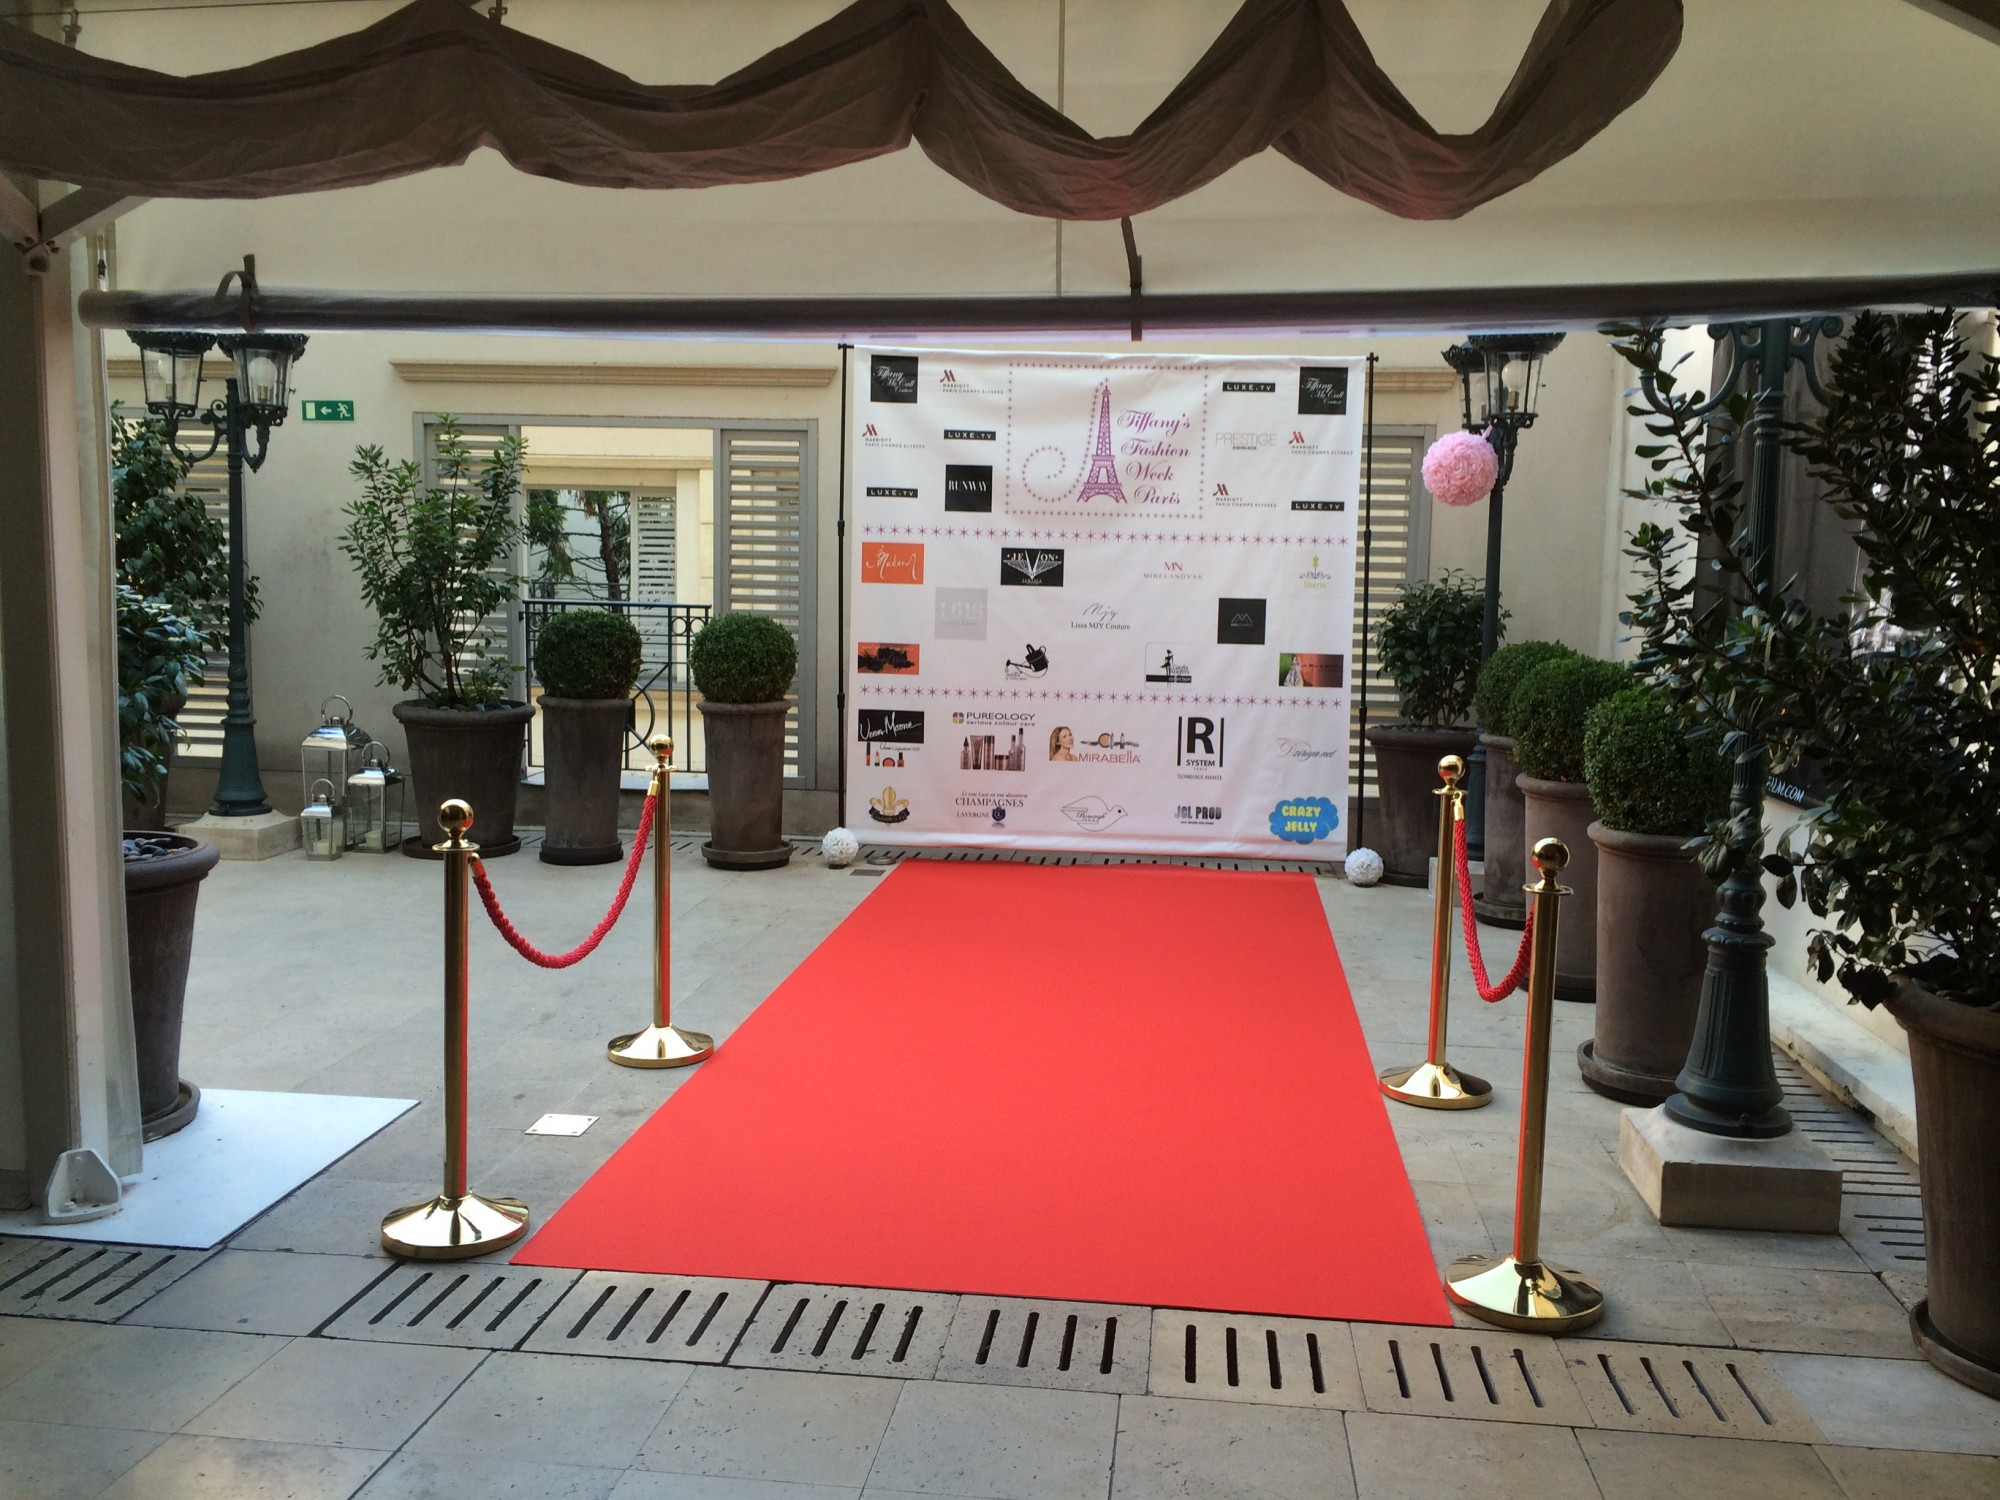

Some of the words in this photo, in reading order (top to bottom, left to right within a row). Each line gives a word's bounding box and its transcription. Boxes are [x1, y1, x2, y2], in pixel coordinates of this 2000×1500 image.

[1226, 383, 1271, 391] LUXE.TV
[1117, 410, 1190, 437] Tiffany's
[948, 431, 992, 439] LUXE.TV
[1215, 432, 1278, 447] PRESTIGE
[1120, 438, 1190, 457] Fashion
[1125, 460, 1174, 481] Week
[948, 480, 987, 492] RUNWAY
[870, 489, 914, 497] LUXE.TV
[1133, 486, 1180, 505] Paris
[1295, 502, 1342, 510] LUXE.TV
[966, 711, 1036, 721] PUREOLOGY
[1186, 759, 1216, 767] SYSTEM
[955, 796, 1024, 807] CHAMPAGNES
[1195, 806, 1222, 820] PROD
[1281, 805, 1321, 818] CRAZY
[1284, 821, 1318, 833] JELLY
